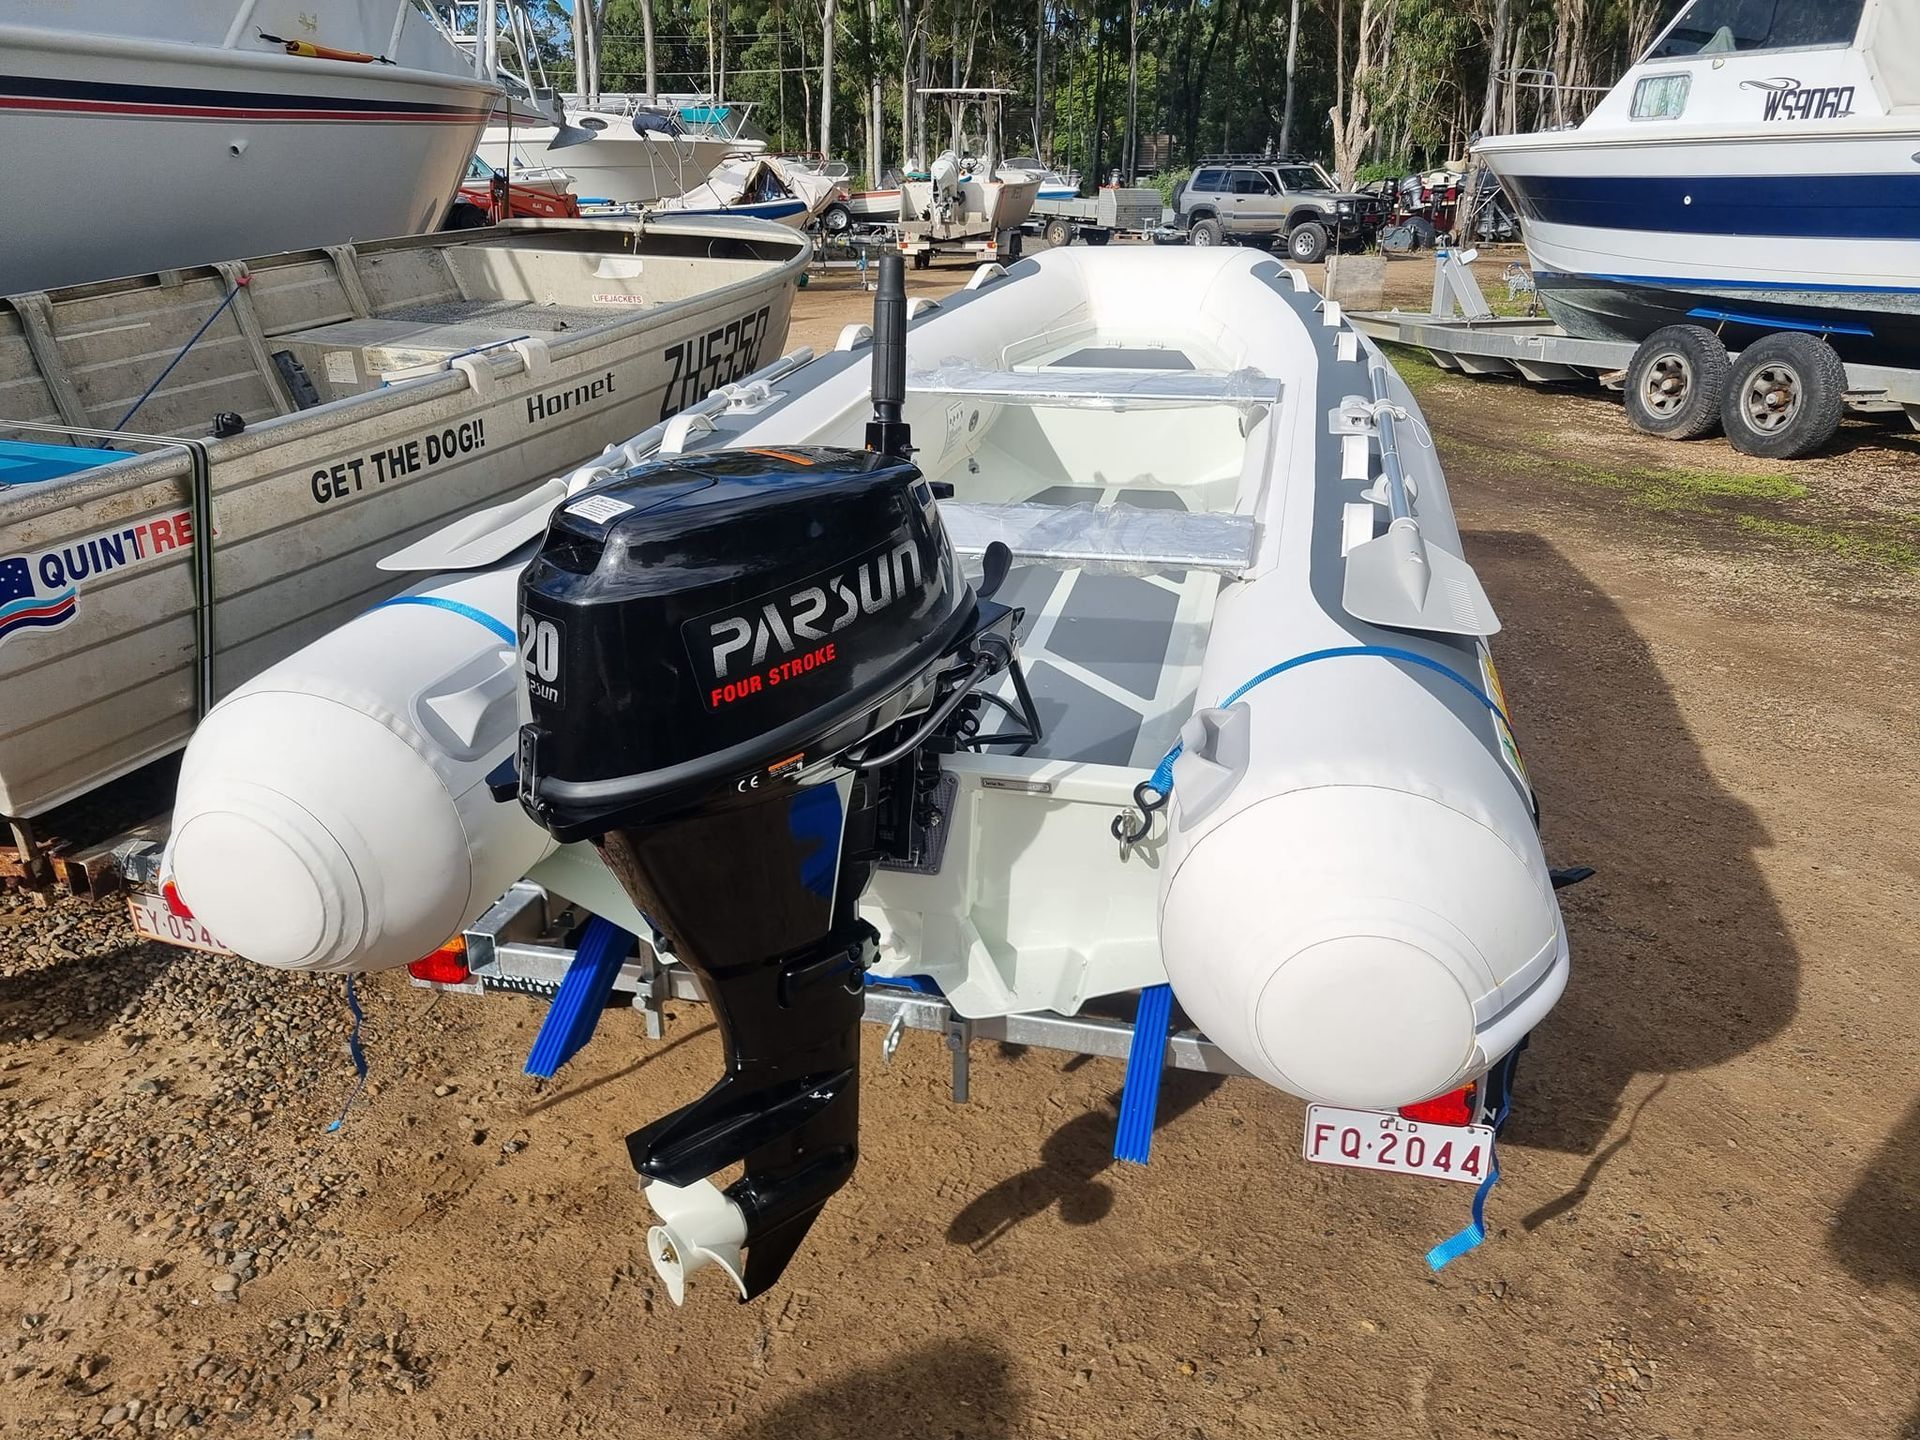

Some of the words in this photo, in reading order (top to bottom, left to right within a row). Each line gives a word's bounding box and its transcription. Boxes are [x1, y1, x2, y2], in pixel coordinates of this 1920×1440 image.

[593, 294, 642, 303] LIFEJACKETS
[527, 371, 616, 423] Hornet
[311, 458, 364, 504] GET
[371, 441, 421, 483] THE
[426, 418, 485, 465] DOG!!
[39, 511, 218, 589] QUINTRE
[710, 539, 922, 678] PARSUN
[521, 613, 559, 682] 20
[711, 674, 762, 708] FOUR
[769, 643, 837, 686] STROKE
[483, 978, 552, 994] TRAILERS
[1380, 1119, 1417, 1133] QLD
